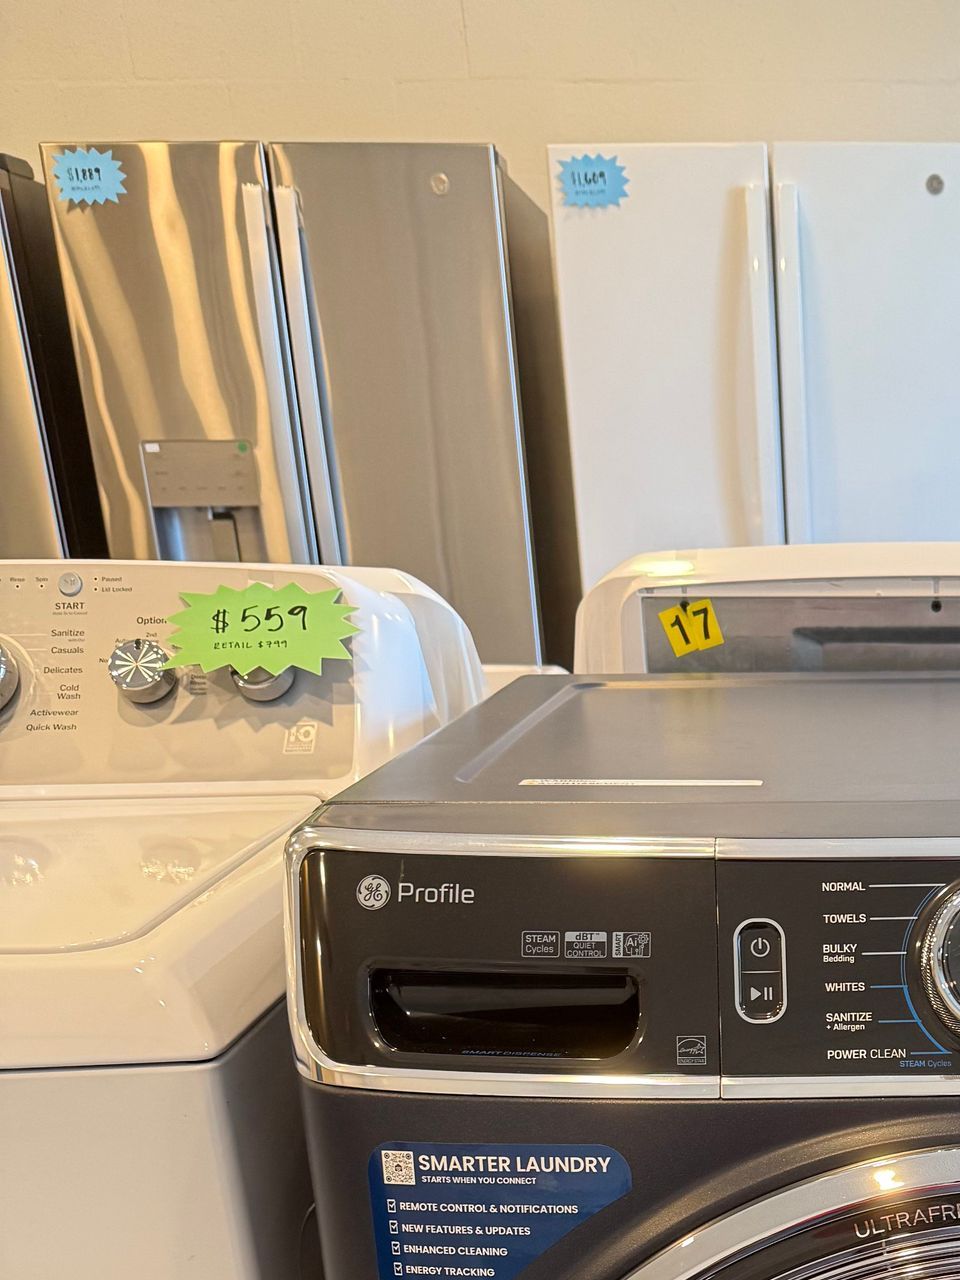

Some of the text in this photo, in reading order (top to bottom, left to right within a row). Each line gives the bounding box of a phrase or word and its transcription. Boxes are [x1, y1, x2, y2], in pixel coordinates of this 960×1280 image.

[55, 602, 85, 610] START
[241, 605, 307, 632] 559
[51, 629, 85, 637] Sanitize
[214, 640, 288, 650] RETAIL $799
[51, 646, 84, 654] Casuals
[60, 684, 79, 692] Cold
[57, 692, 81, 700] Wash
[822, 882, 866, 891] NORMAL
[398, 882, 475, 904] Profile
[823, 914, 866, 924] TOWELS
[525, 935, 556, 943] STEAM
[525, 945, 554, 954] Cycles
[822, 944, 857, 953] BULKY
[823, 955, 855, 963] Bedding
[825, 983, 865, 992] WHITES
[826, 1013, 873, 1022] SANITIZE
[833, 1023, 865, 1032] Allergen
[827, 1049, 906, 1060] POWER CLEAN
[928, 1060, 951, 1068] Cycles
[418, 1154, 611, 1174] SMARTER LAUNDRY
[421, 1175, 537, 1185] STARTS WHEN YOU CONNECT
[400, 1202, 579, 1215] REMOTE CONTROL & NOTIFICATIONS
[401, 1223, 531, 1236] NEW FEATURES & UPDATES
[403, 1244, 508, 1257] ENHANCED CLEANING
[405, 1265, 495, 1277] ENERGY TRACKING
